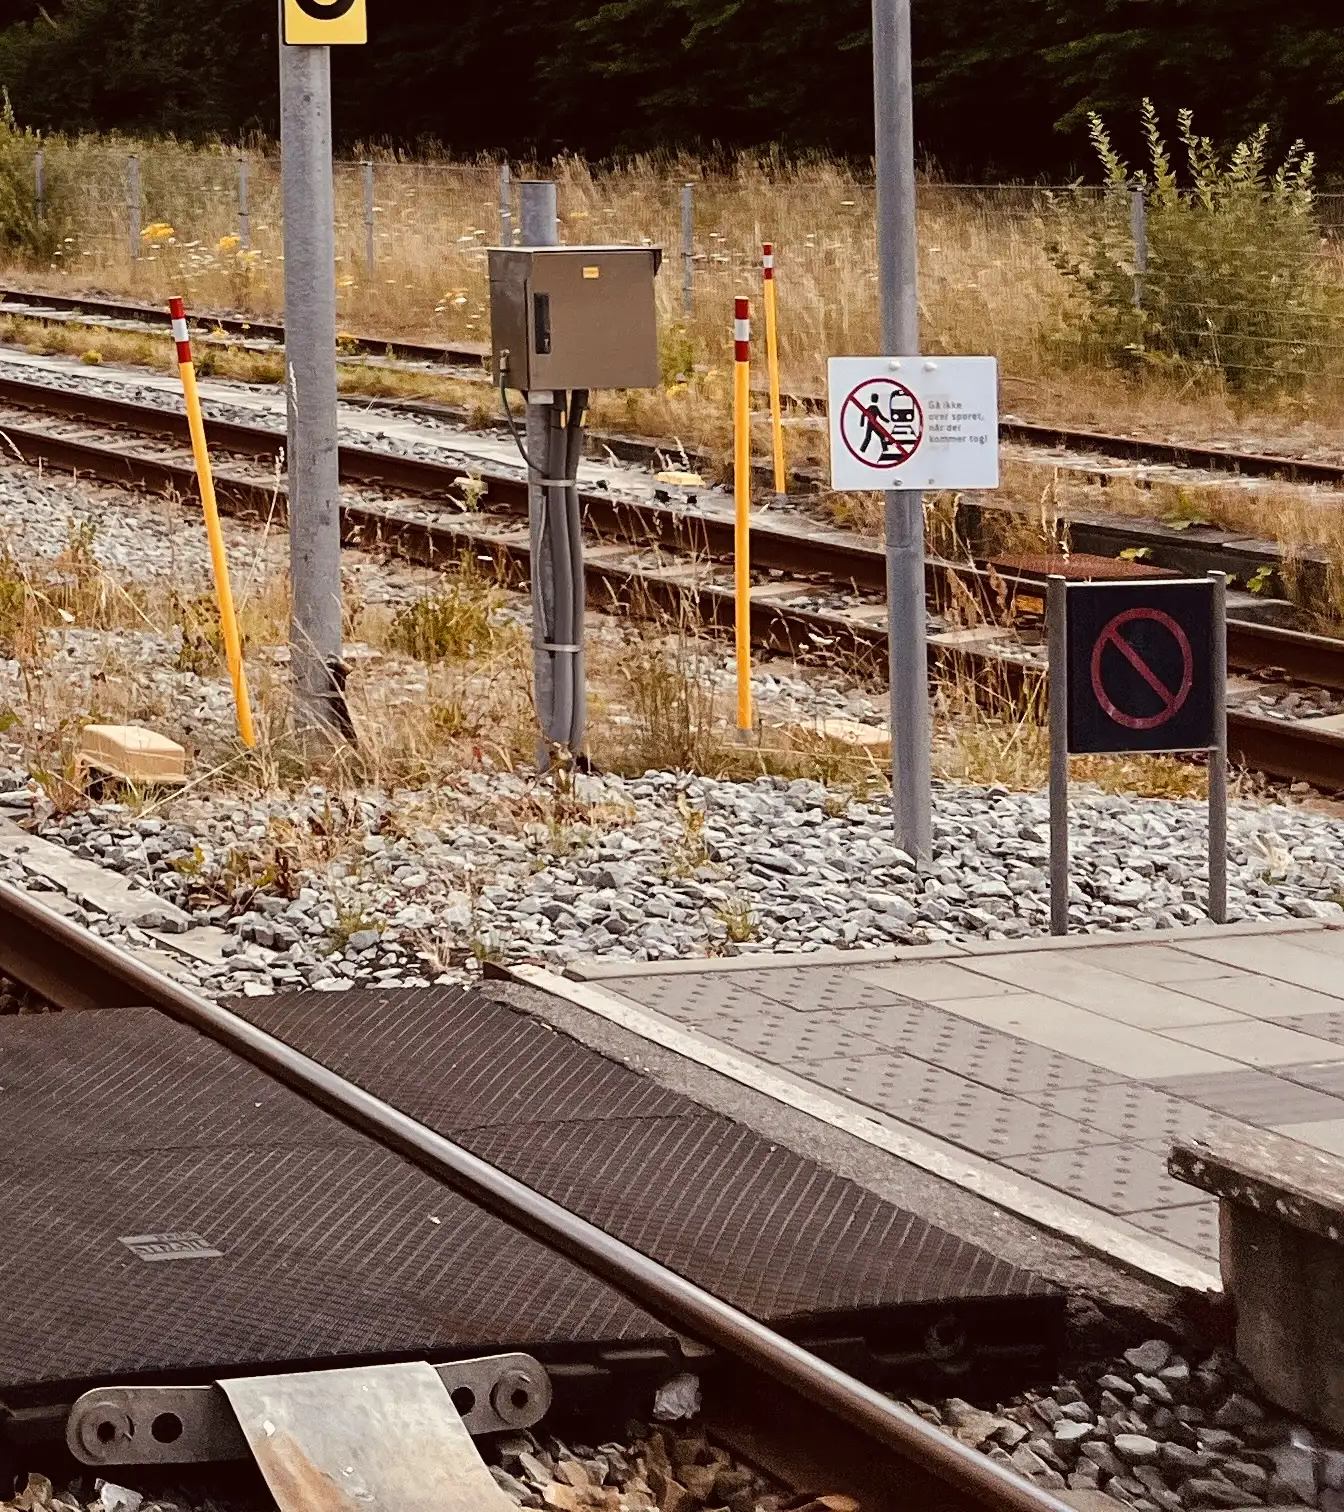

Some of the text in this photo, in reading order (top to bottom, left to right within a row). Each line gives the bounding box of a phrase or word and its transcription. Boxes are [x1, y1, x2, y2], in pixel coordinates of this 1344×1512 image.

[928, 400, 962, 409] Gå ikke
[928, 413, 948, 421] over
[928, 435, 967, 443] kommer
